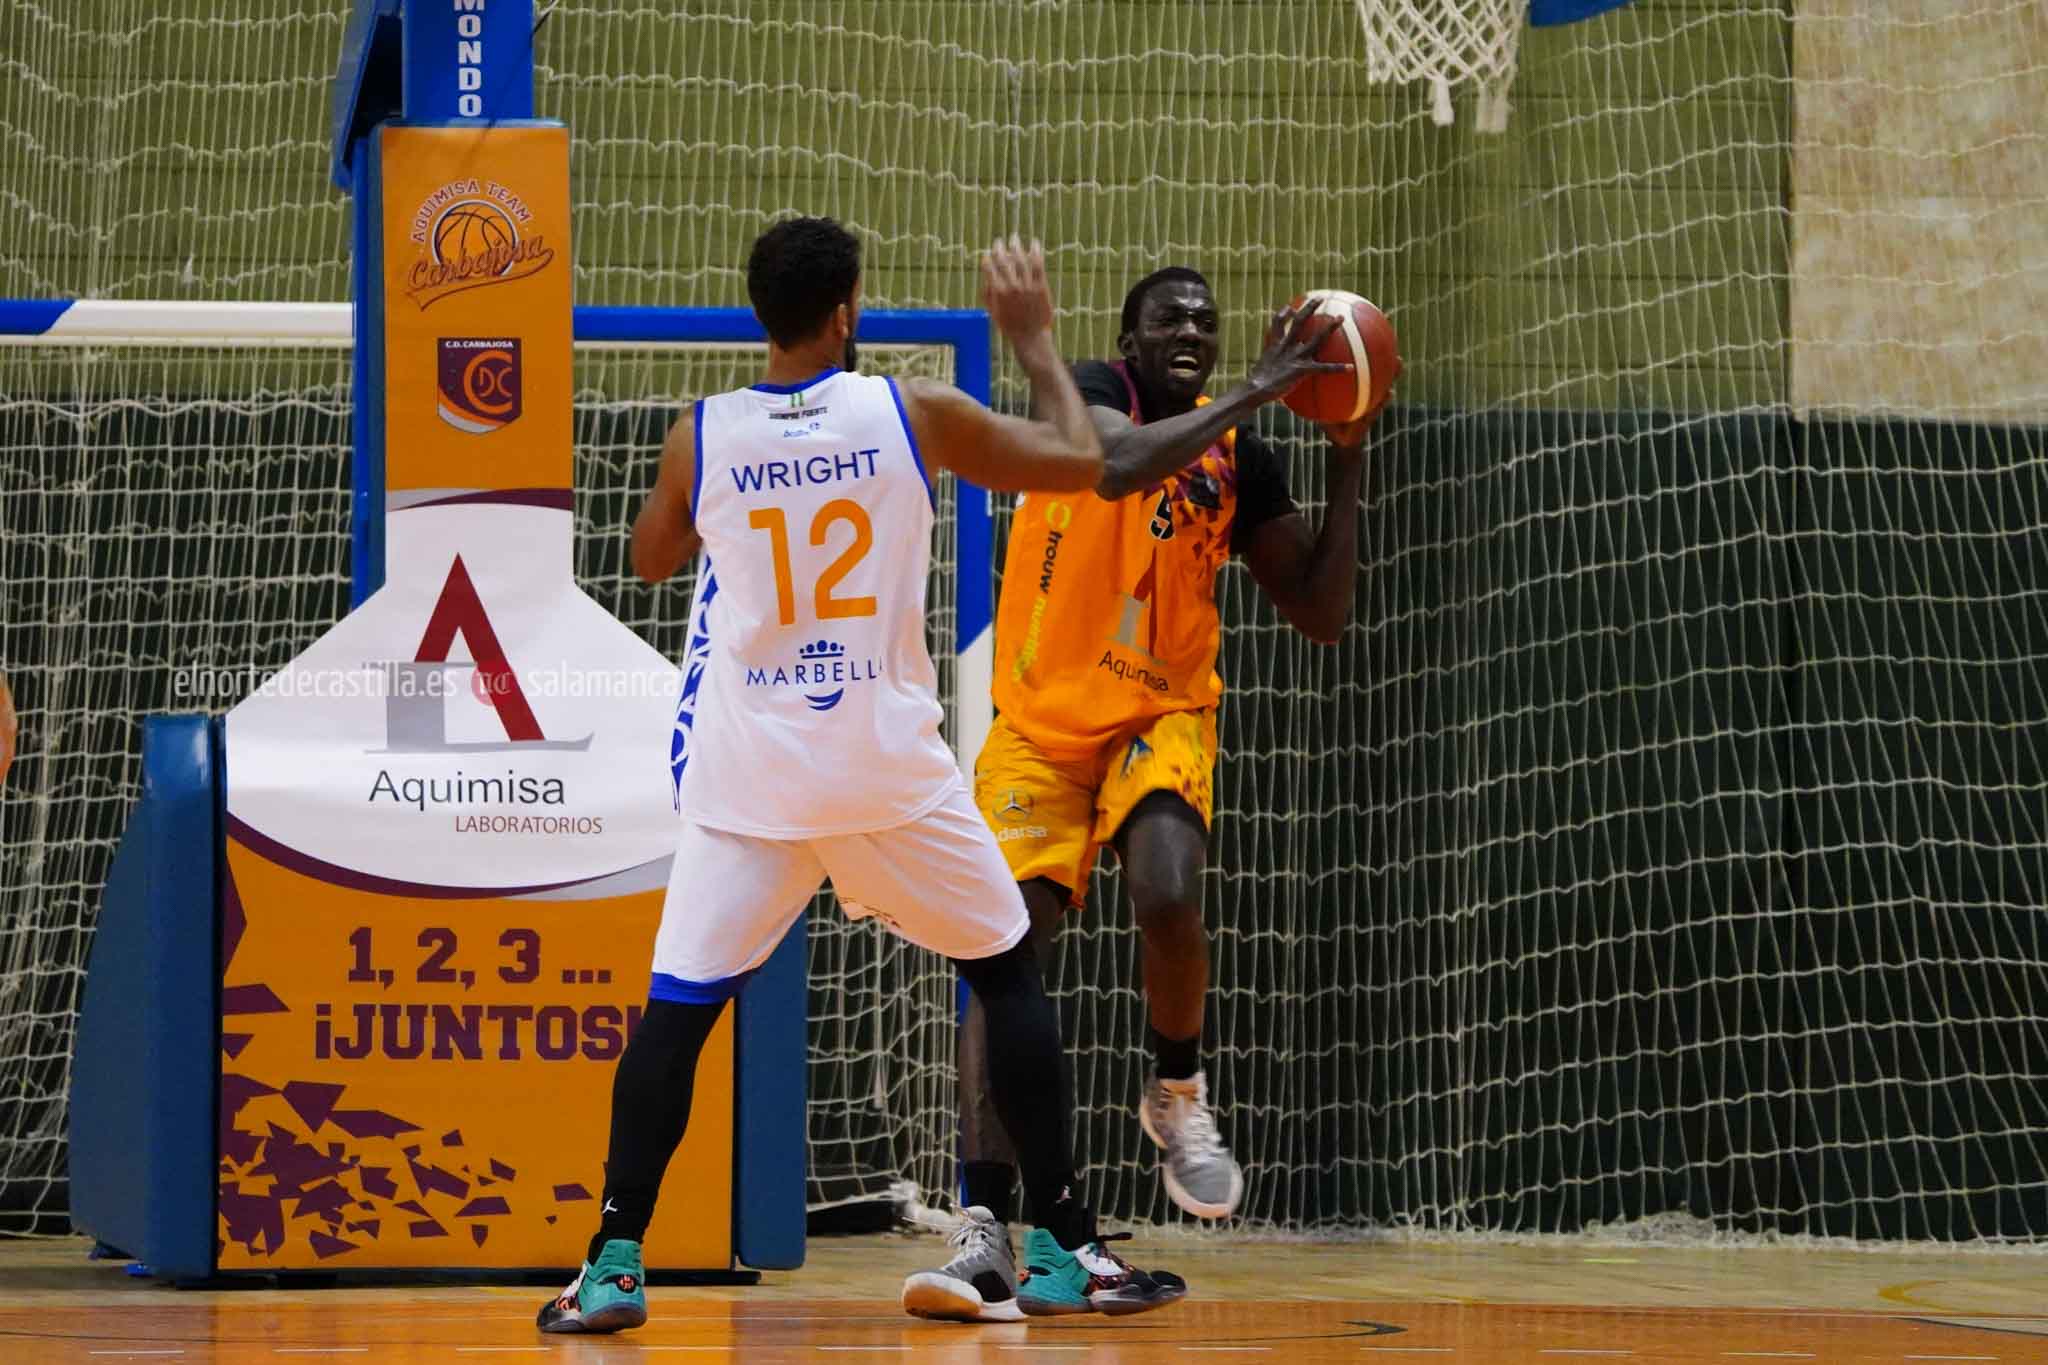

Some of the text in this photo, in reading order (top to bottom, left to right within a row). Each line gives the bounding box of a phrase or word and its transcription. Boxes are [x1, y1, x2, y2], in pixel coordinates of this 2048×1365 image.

[410, 177, 534, 244] AQUIMISA TEAM
[730, 448, 880, 494] WRIGHT
[749, 498, 877, 626] 12
[1039, 530, 1063, 595] trouw
[746, 655, 883, 687] MARBELL
[368, 769, 565, 811] Aquimisa
[455, 815, 604, 835] LABORATORIOS
[347, 926, 395, 991] 1,
[416, 927, 476, 991] 2,
[497, 927, 541, 984] 3
